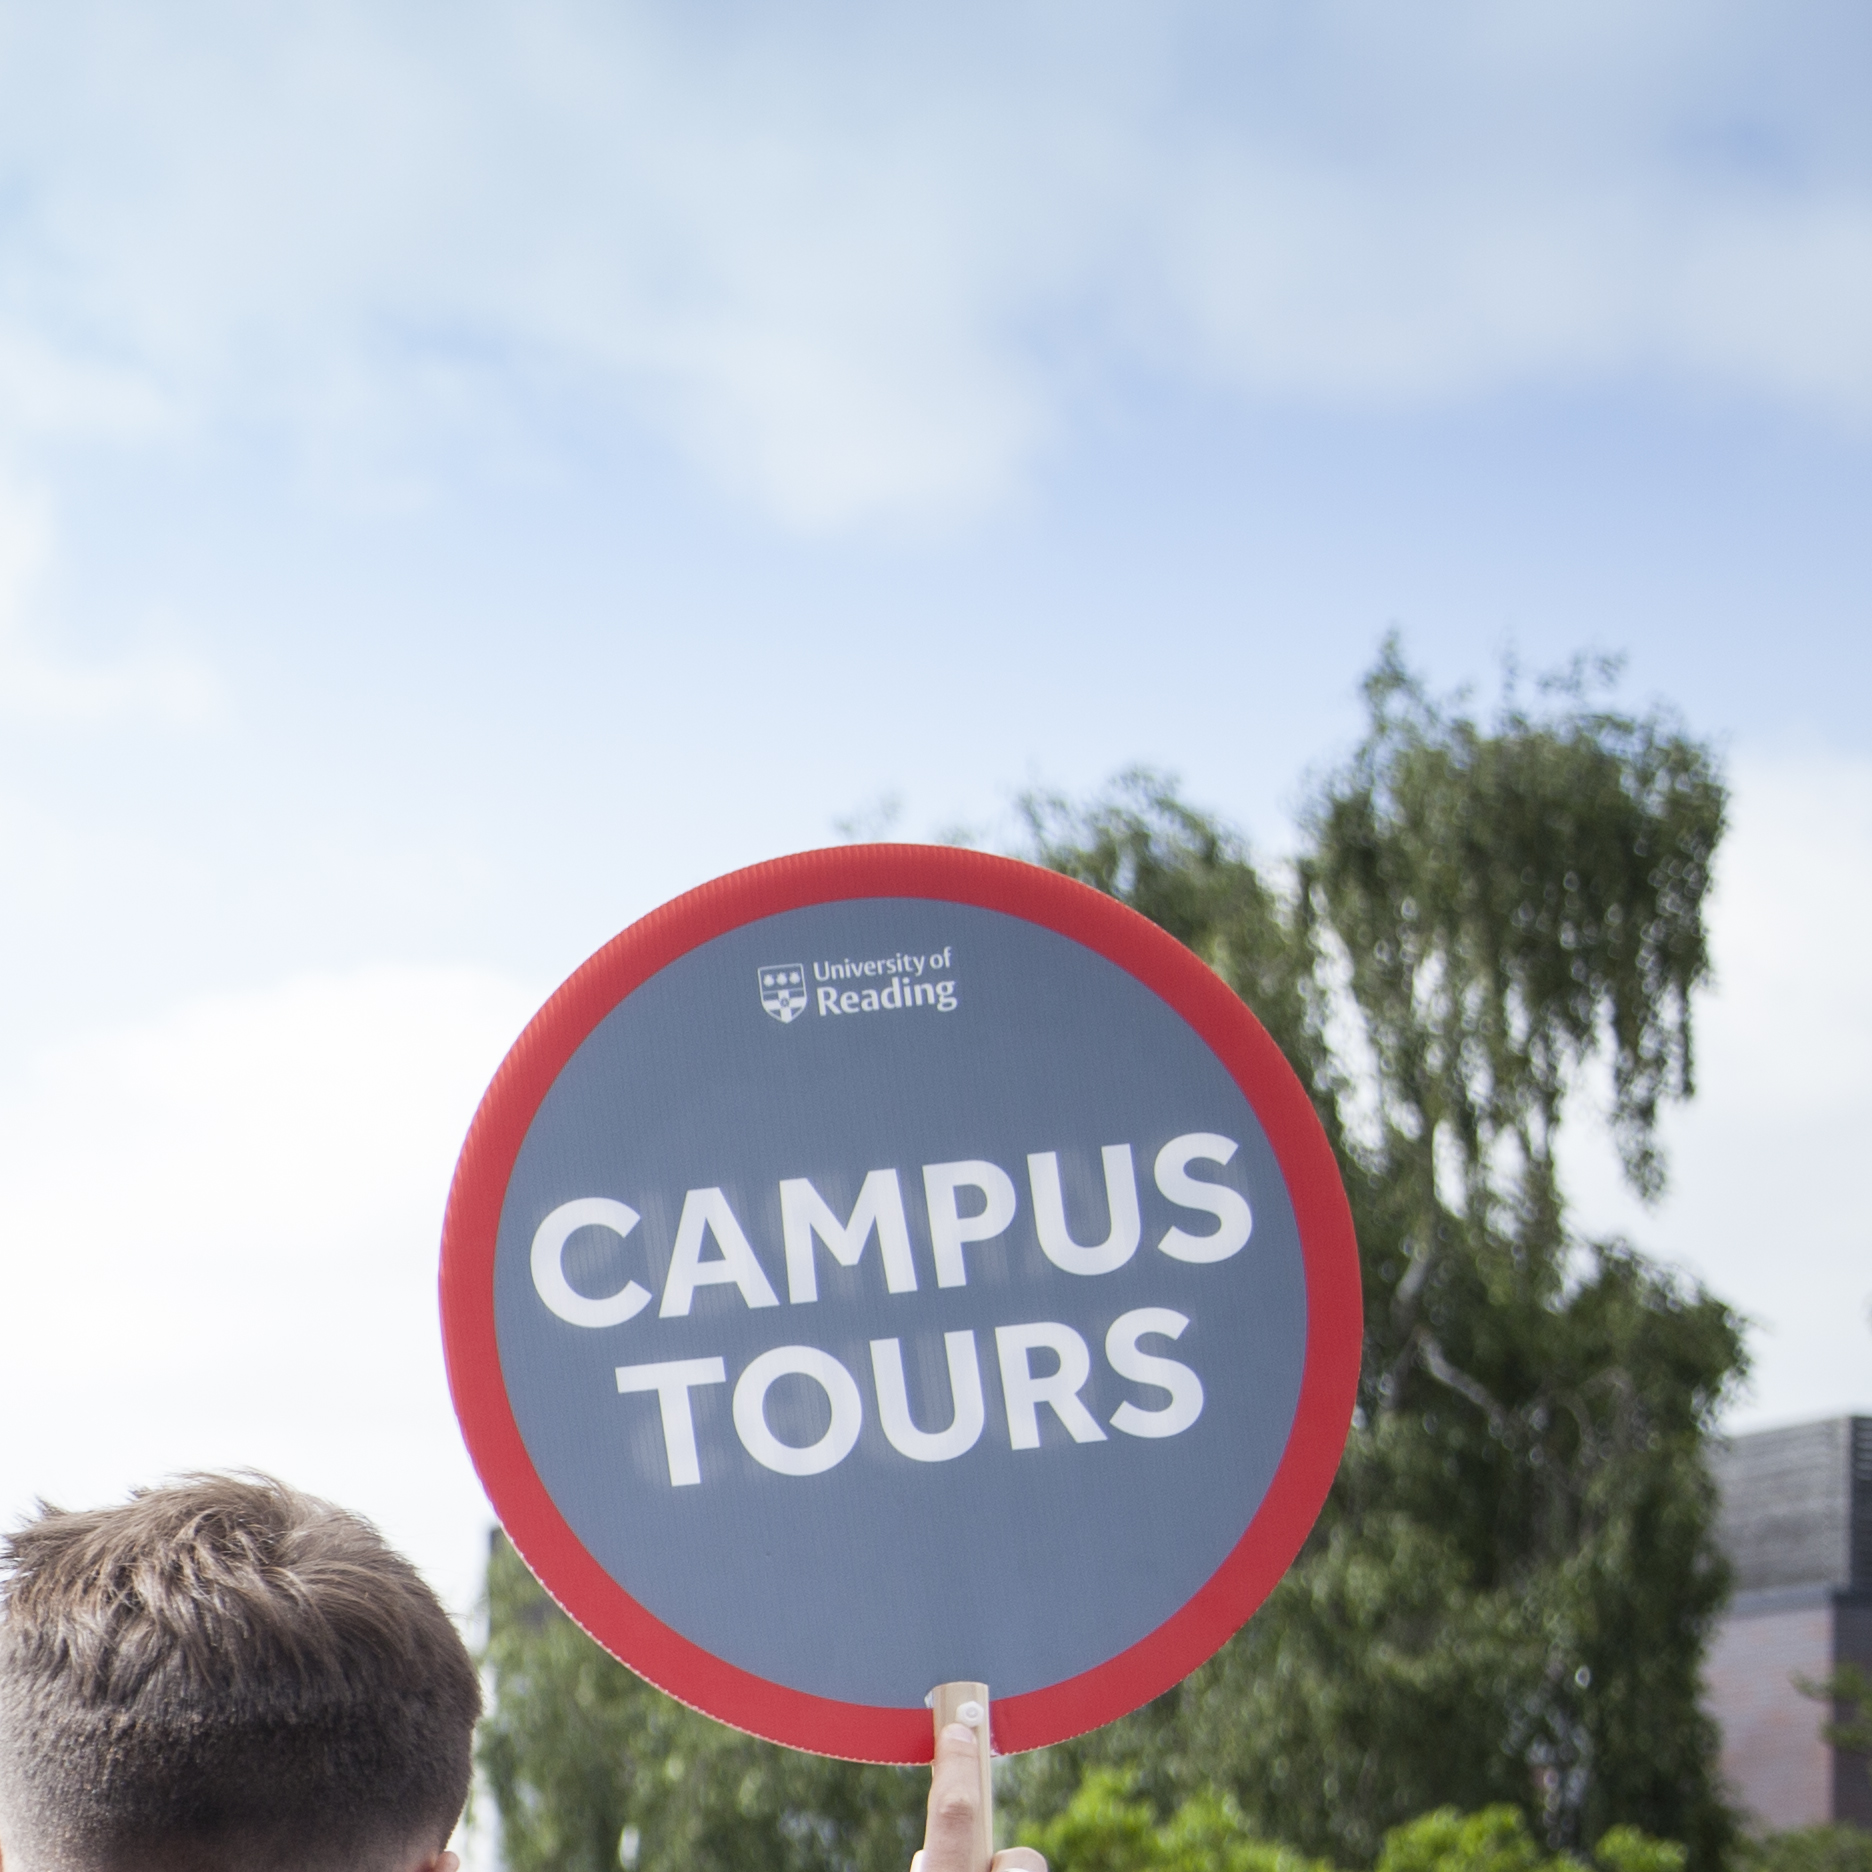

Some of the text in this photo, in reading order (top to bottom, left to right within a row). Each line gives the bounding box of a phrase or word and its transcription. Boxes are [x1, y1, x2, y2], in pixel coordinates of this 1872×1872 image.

[813, 946, 952, 982] University of
[816, 976, 958, 1017] Reading
[530, 1132, 1253, 1329] CAMPUS
[614, 1307, 1204, 1487] TOURS
